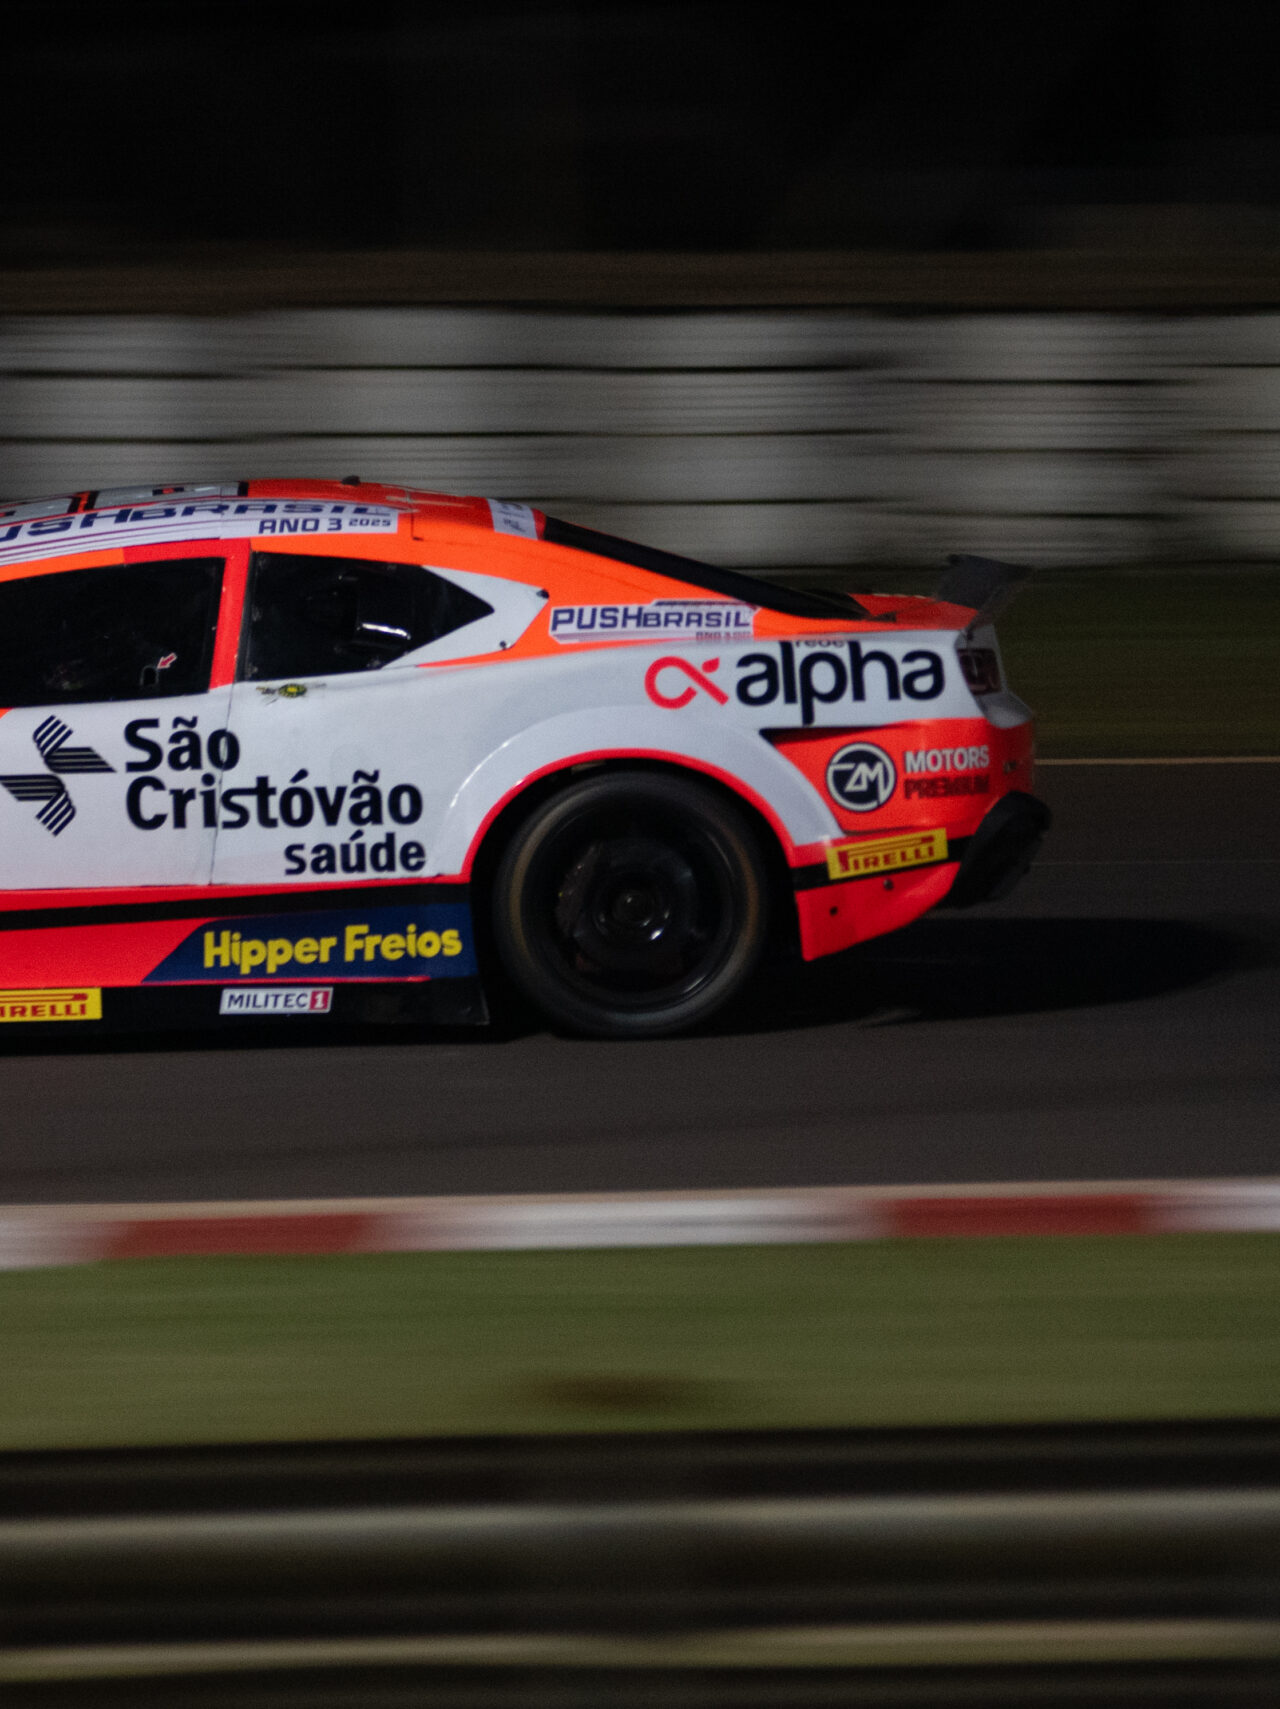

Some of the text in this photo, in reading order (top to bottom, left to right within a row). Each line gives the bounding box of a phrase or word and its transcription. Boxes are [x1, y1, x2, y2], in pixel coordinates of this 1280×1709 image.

[258, 517, 391, 534] ANO 3 2025
[551, 606, 750, 632] PUSHBRASIL
[736, 640, 945, 727] alpha
[123, 716, 240, 772] São
[904, 745, 990, 773] MOTORS
[125, 769, 423, 830] Cristóvão
[284, 829, 426, 876] saúde
[837, 835, 935, 874] PIRELLI
[203, 923, 463, 975] Hipper Freios
